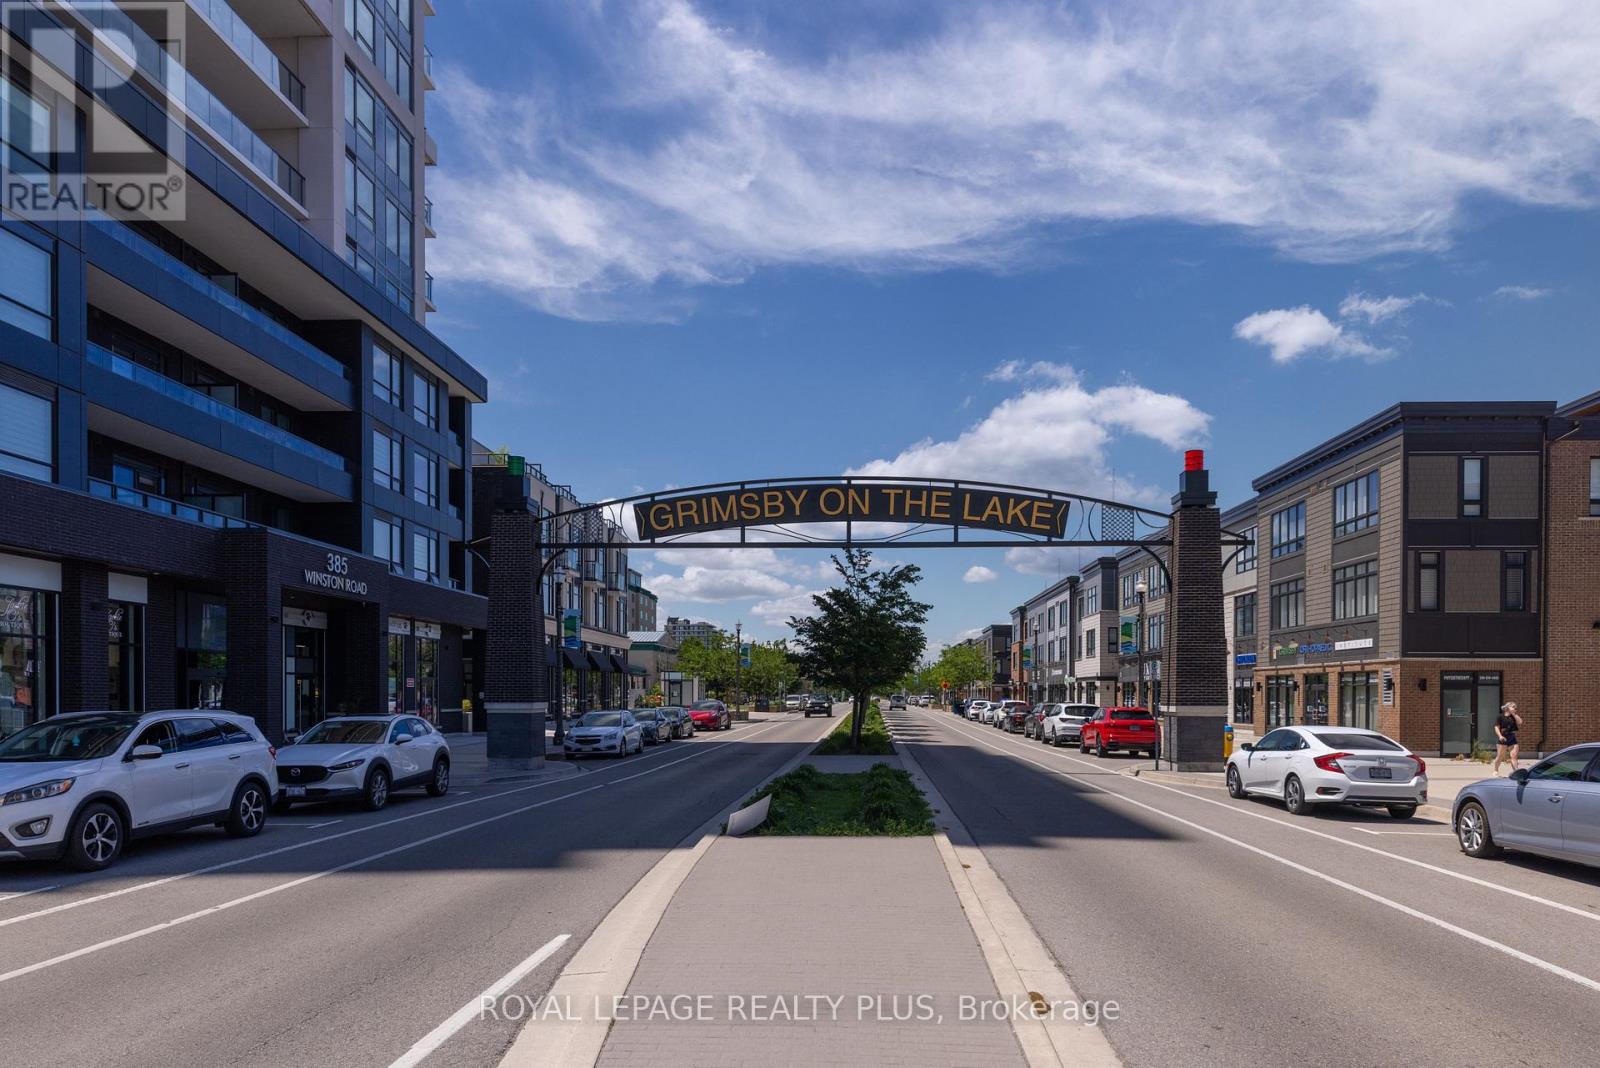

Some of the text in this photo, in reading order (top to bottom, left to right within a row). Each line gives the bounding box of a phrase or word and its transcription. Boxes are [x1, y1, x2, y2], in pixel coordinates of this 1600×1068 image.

[649, 488, 1052, 531] GRIMSBY ON THE LAKE
[326, 553, 349, 575] 385
[304, 569, 368, 595] WINSTON ROAD
